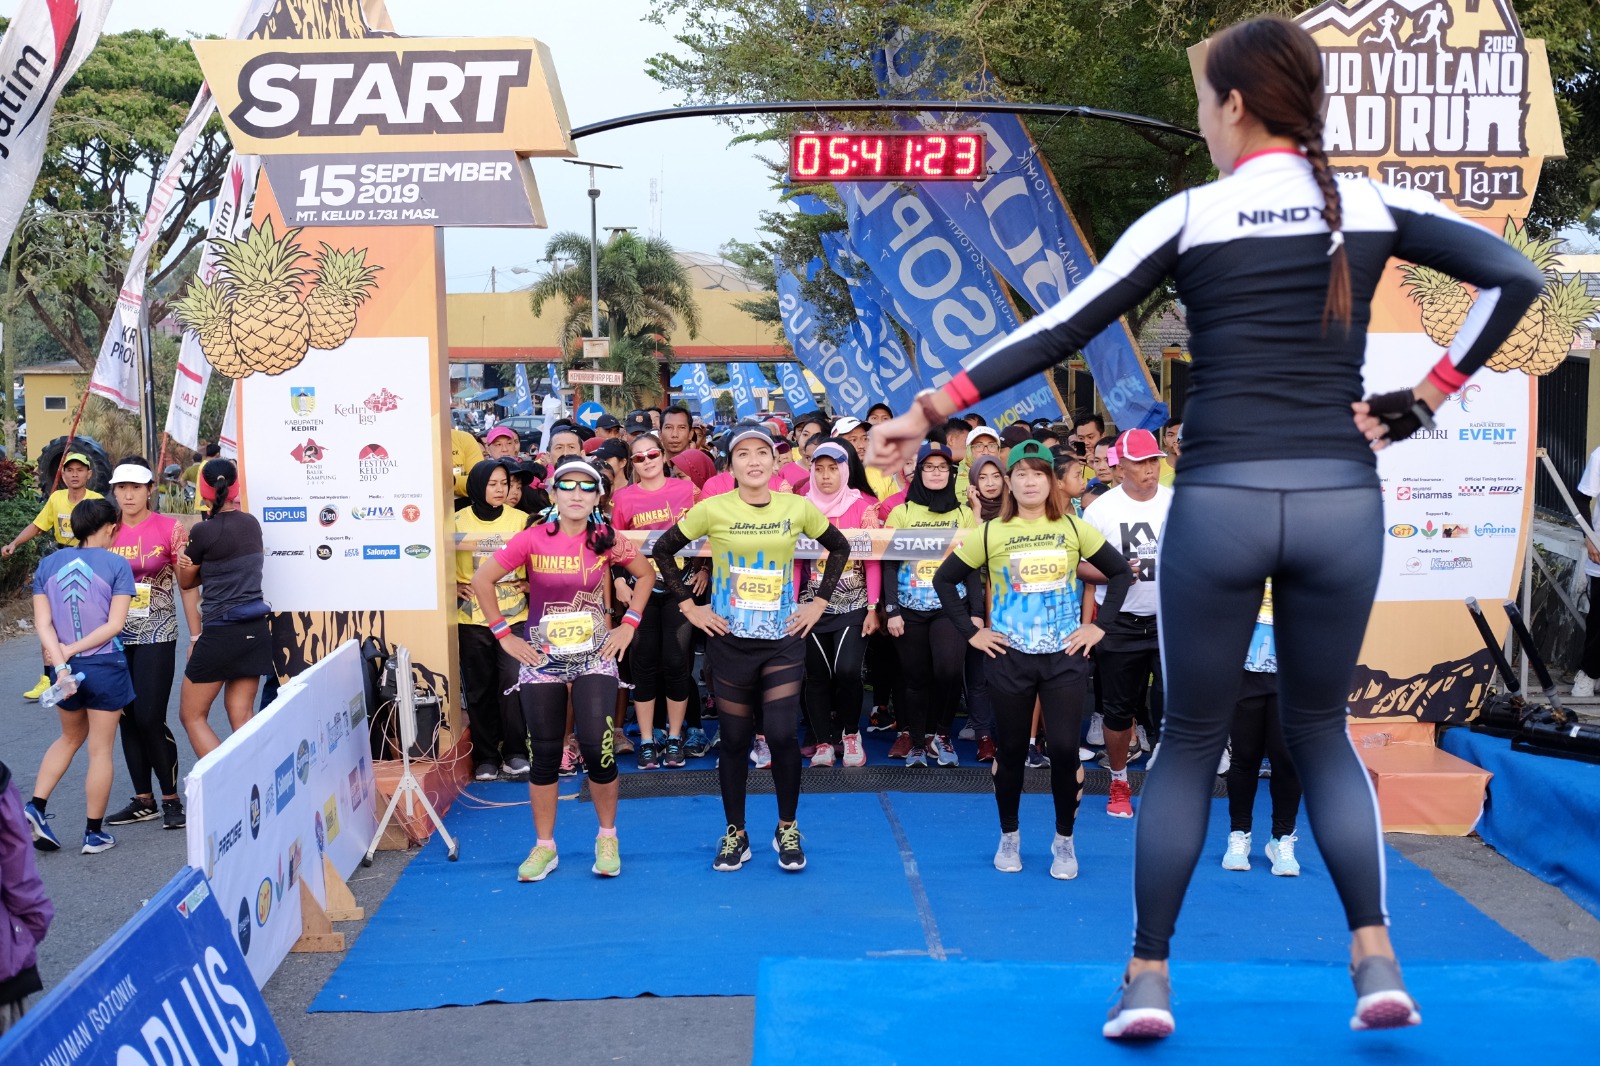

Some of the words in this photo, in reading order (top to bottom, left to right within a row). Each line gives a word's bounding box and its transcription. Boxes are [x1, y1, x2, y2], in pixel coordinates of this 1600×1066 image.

[1484, 36, 1516, 53] 2019
[1370, 52, 1523, 94] VOLCANO
[244, 60, 519, 128] START
[1323, 95, 1386, 152] AD
[296, 164, 356, 207] 15
[359, 162, 512, 184] SEPTEMBER
[357, 184, 420, 204] 2019
[296, 211, 318, 222] MT.
[321, 210, 365, 221] KELUD
[402, 209, 439, 220] MASL
[1459, 428, 1516, 441] EVENT
[359, 460, 398, 468] FESTIVAL
[359, 474, 377, 482] 2019
[1412, 491, 1453, 499] sinarmas
[265, 511, 306, 520] ISOPLUS
[367, 507, 394, 516] HVA
[894, 538, 945, 550] START
[1021, 564, 1058, 575] 4250
[739, 582, 772, 594] 4251
[549, 626, 584, 638] 4273
[87, 973, 138, 1035] ISOTONIK
